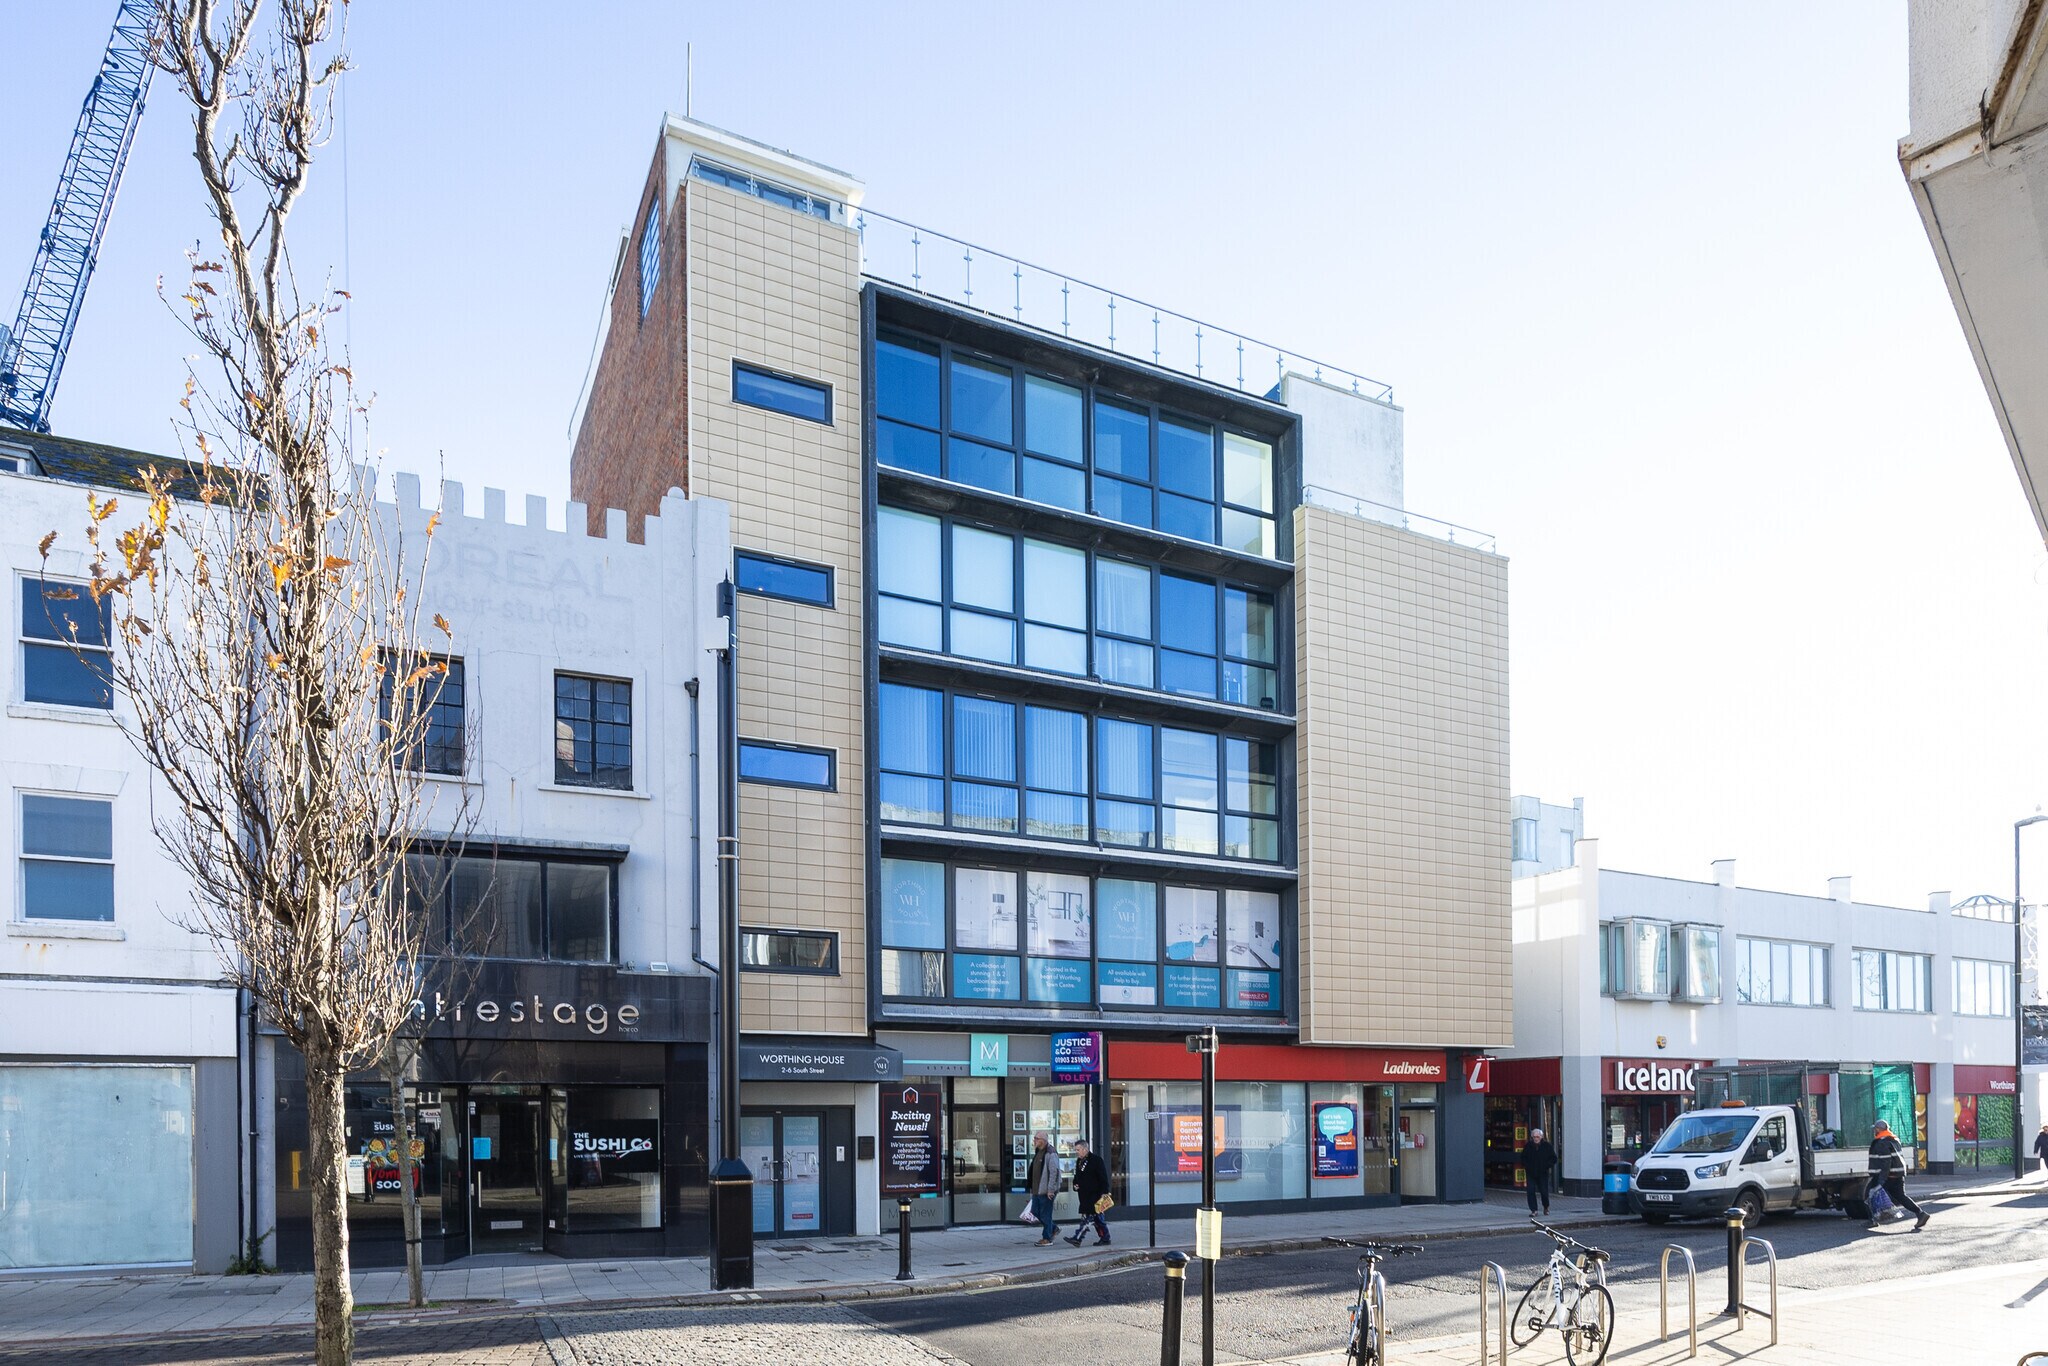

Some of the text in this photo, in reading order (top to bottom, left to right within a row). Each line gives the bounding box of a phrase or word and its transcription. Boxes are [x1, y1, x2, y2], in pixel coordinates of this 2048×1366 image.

[1055, 1038, 1091, 1047] JUSTICE
[1055, 1047, 1072, 1055] &Co
[759, 1054, 845, 1065] WORTHING HOUSE
[1055, 1056, 1070, 1064] 01903
[1383, 1061, 1441, 1075] Ladbrokes
[1074, 1074, 1091, 1082] LET
[1990, 1080, 2015, 1091] Worthing
[891, 1110, 931, 1122] Exciting
[894, 1121, 928, 1131] News!!
[573, 1138, 653, 1151] SUSHI Co
[376, 1180, 402, 1189] SOO
